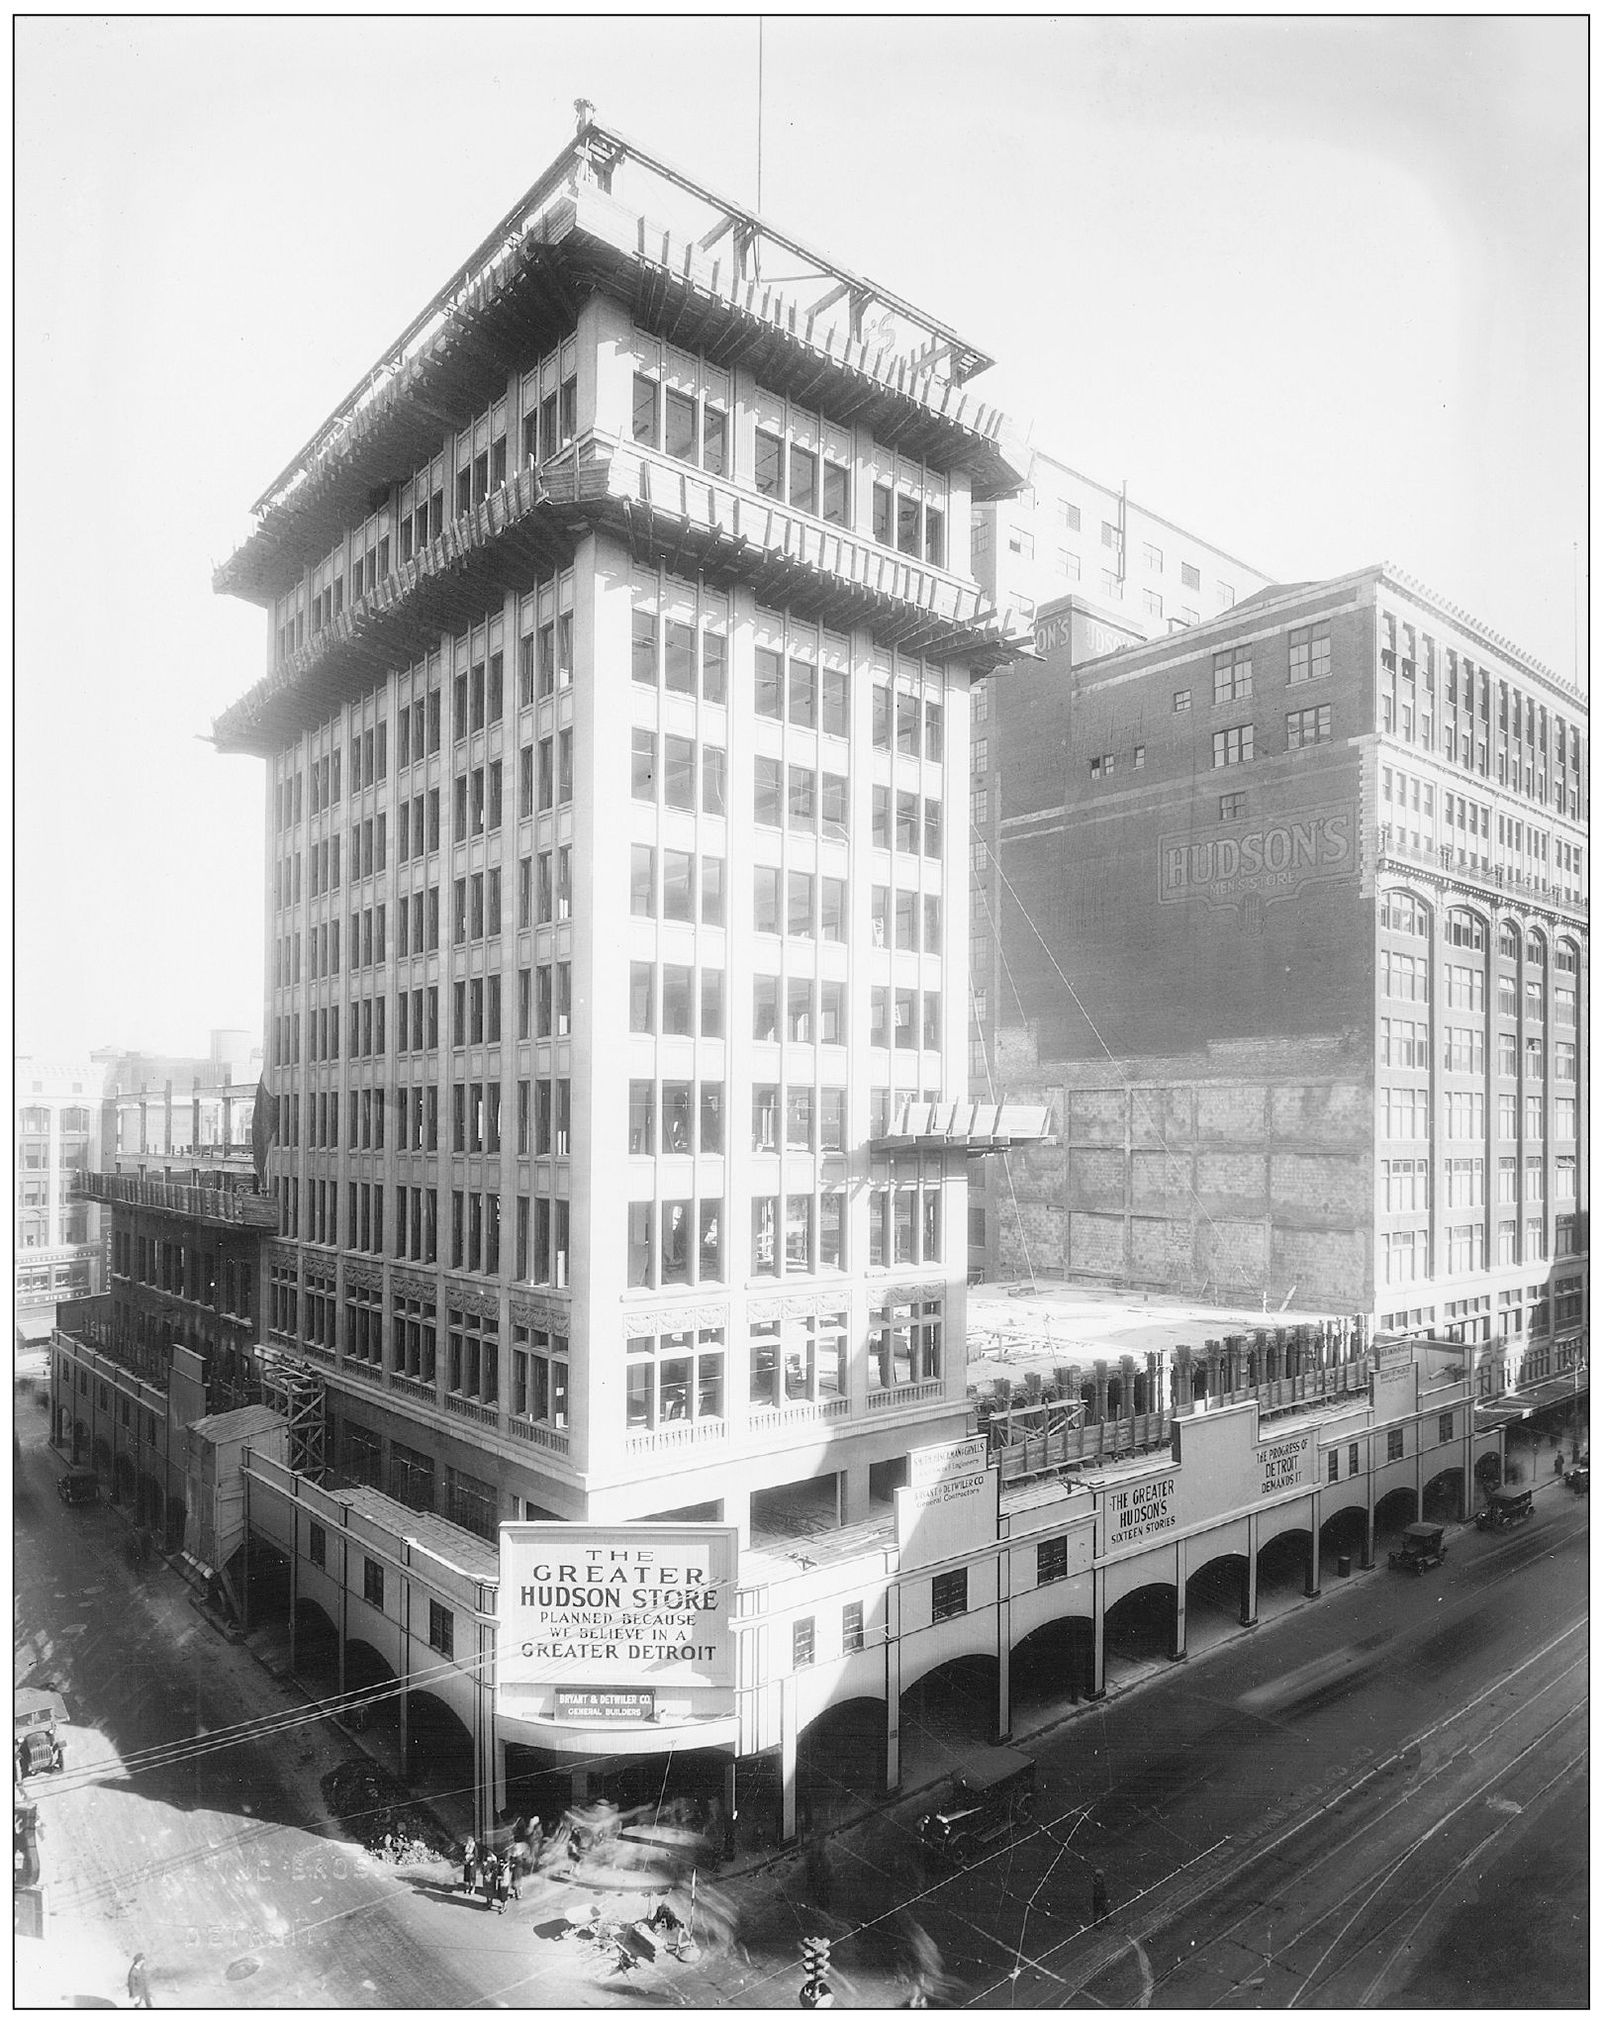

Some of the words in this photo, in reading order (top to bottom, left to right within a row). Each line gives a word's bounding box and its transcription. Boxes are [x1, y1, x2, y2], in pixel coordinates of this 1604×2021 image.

[1166, 814, 1349, 888] HUDSON'S
[1249, 871, 1297, 890] STORE
[1257, 1450, 1267, 1464] THE
[1269, 1440, 1300, 1461] PROGRESS
[1301, 1438, 1309, 1450] OF
[1265, 1455, 1299, 1479] DETROIT
[1261, 1473, 1294, 1494] DEMANDS
[1295, 1471, 1302, 1483] IT
[943, 1487, 980, 1502] Contractors
[1111, 1491, 1128, 1511] THE
[1132, 1479, 1174, 1505] GREATER
[1120, 1499, 1167, 1528] HUDSON'S
[1111, 1525, 1143, 1544] SIXTEEN
[1145, 1515, 1176, 1534] STORIES
[585, 1550, 654, 1562] THE
[533, 1564, 705, 1585] GREATER
[520, 1585, 621, 1608] HUDSON
[632, 1588, 719, 1611] STORE
[540, 1611, 613, 1624] PLANNED
[622, 1613, 697, 1626] BECAUSE
[550, 1627, 571, 1638] WE
[579, 1627, 644, 1640] BELIEVE
[652, 1629, 668, 1640] IN
[675, 1630, 687, 1641] A
[521, 1643, 620, 1659] GREATER
[628, 1644, 717, 1661] DETROIT
[559, 1694, 588, 1704] BRYANT
[590, 1694, 598, 1704] &
[599, 1694, 637, 1704] DETWILER
[567, 1707, 602, 1716] GENERAL
[605, 1707, 642, 1717] BUILDERS
